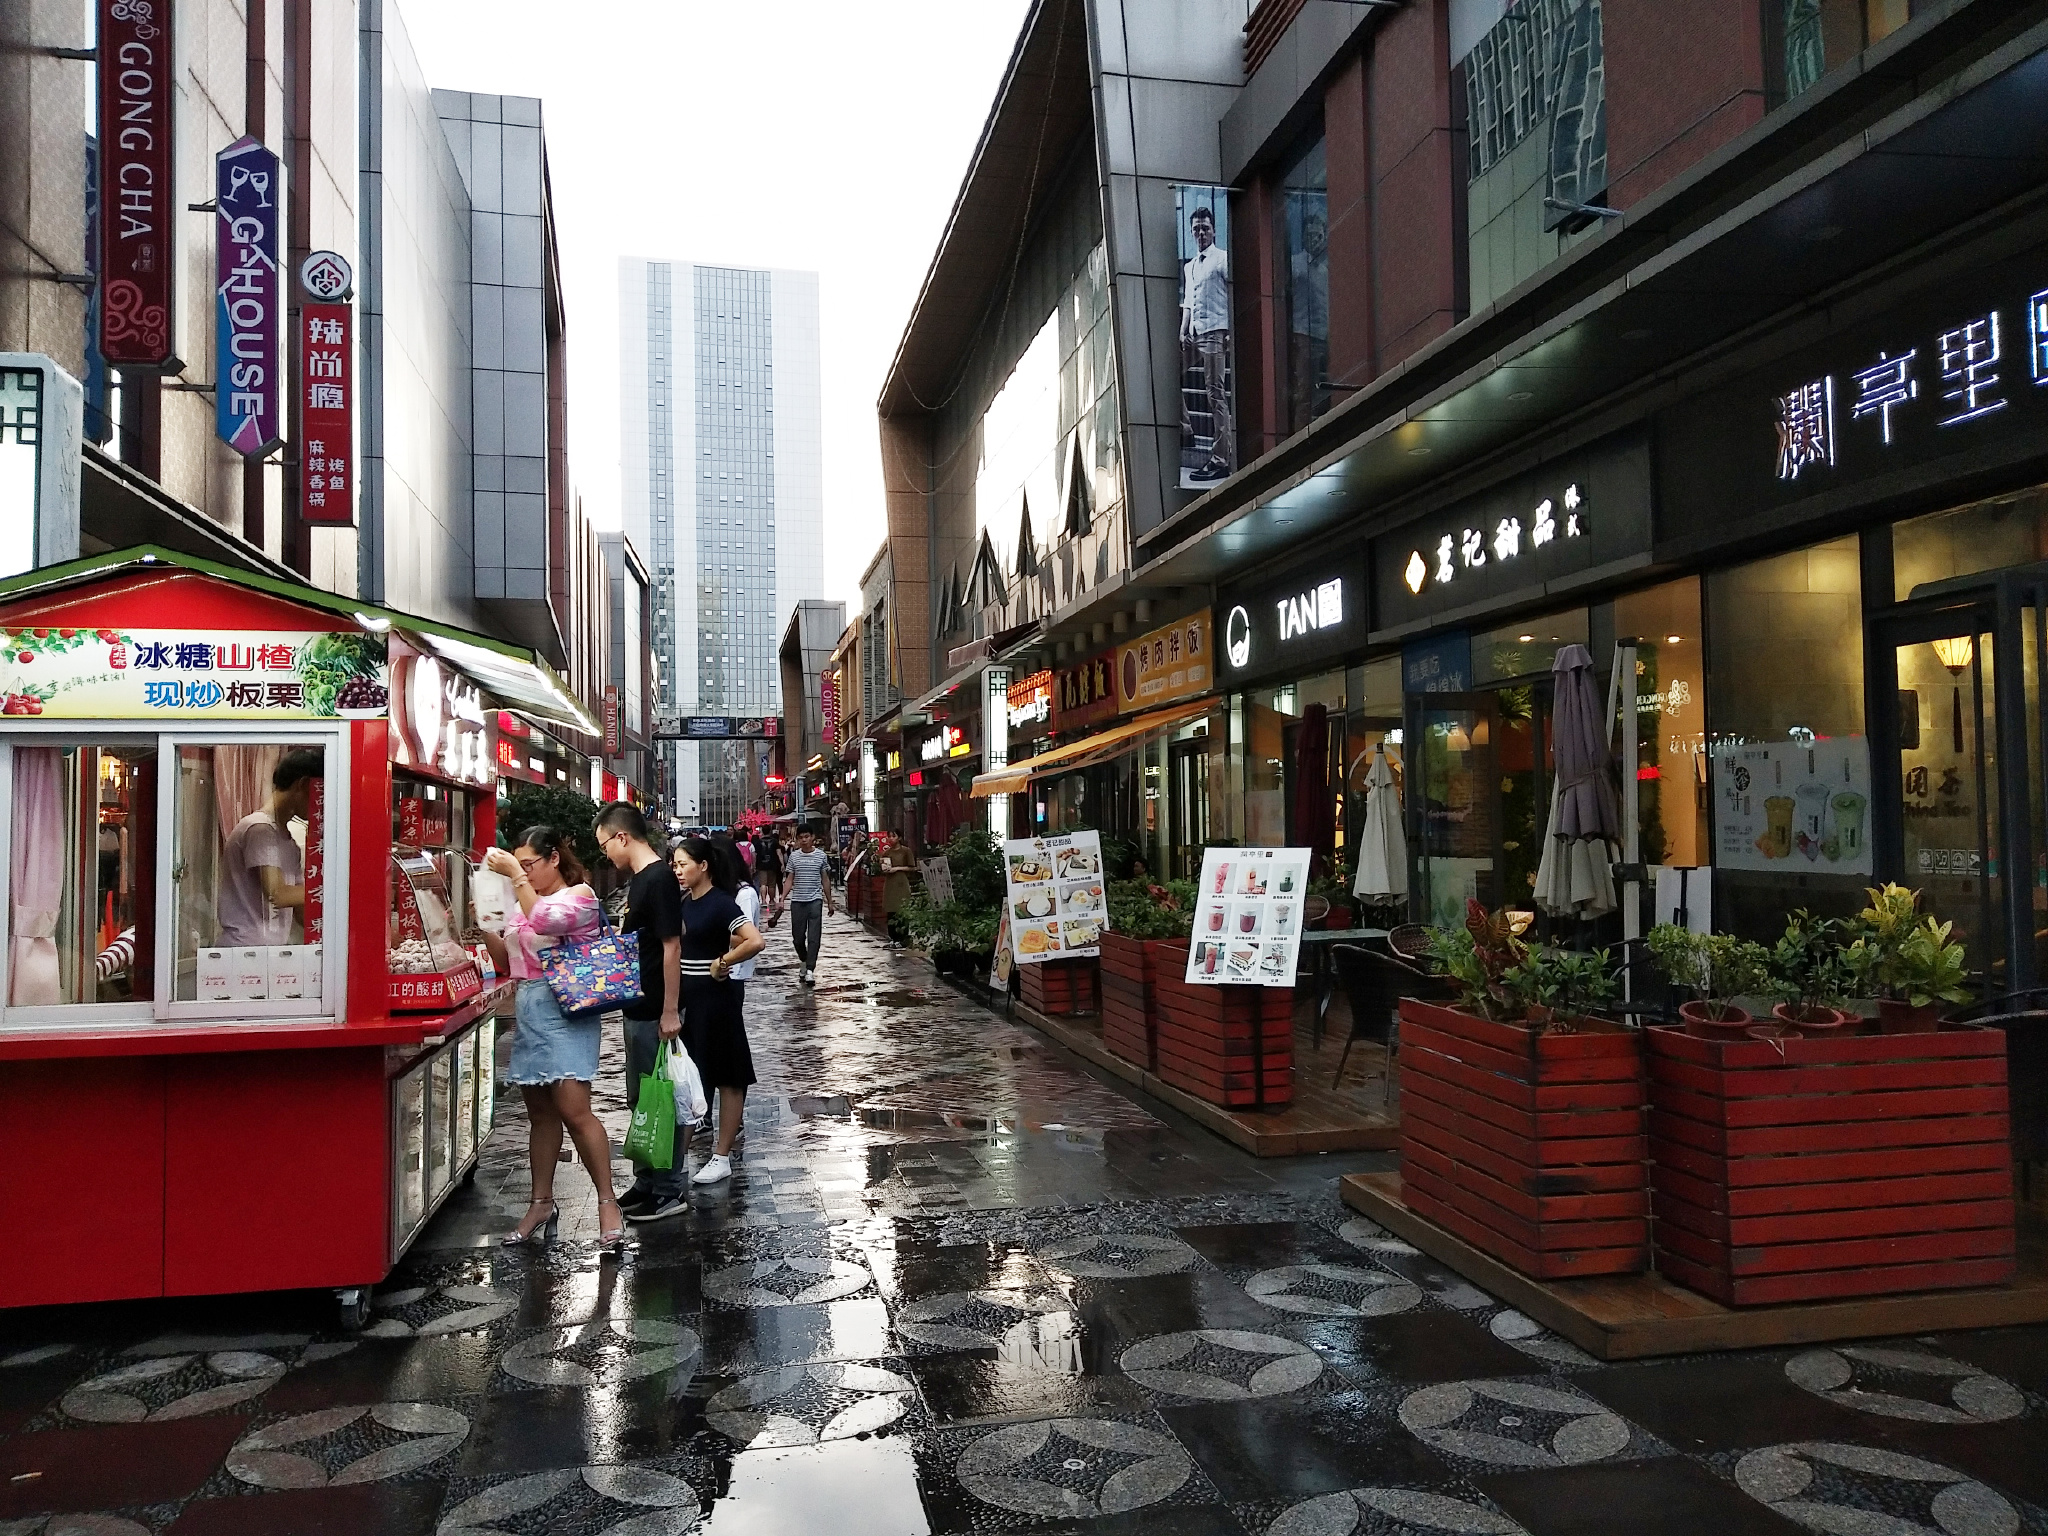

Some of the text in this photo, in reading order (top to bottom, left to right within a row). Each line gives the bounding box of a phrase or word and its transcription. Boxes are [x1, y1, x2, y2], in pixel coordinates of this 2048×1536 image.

[119, 41, 153, 152] GONG
[119, 162, 153, 240] CHA
[308, 317, 345, 410] 辣尚瘾
[308, 440, 326, 507] 麻辣香锅
[328, 457, 346, 490] 烤鱼
[134, 642, 297, 671] 冰糖山楂
[1140, 620, 1200, 673] 烤肉拌饭
[144, 680, 306, 710] 现炒板栗
[606, 708, 616, 747] HANING
[402, 799, 419, 840] 老北京
